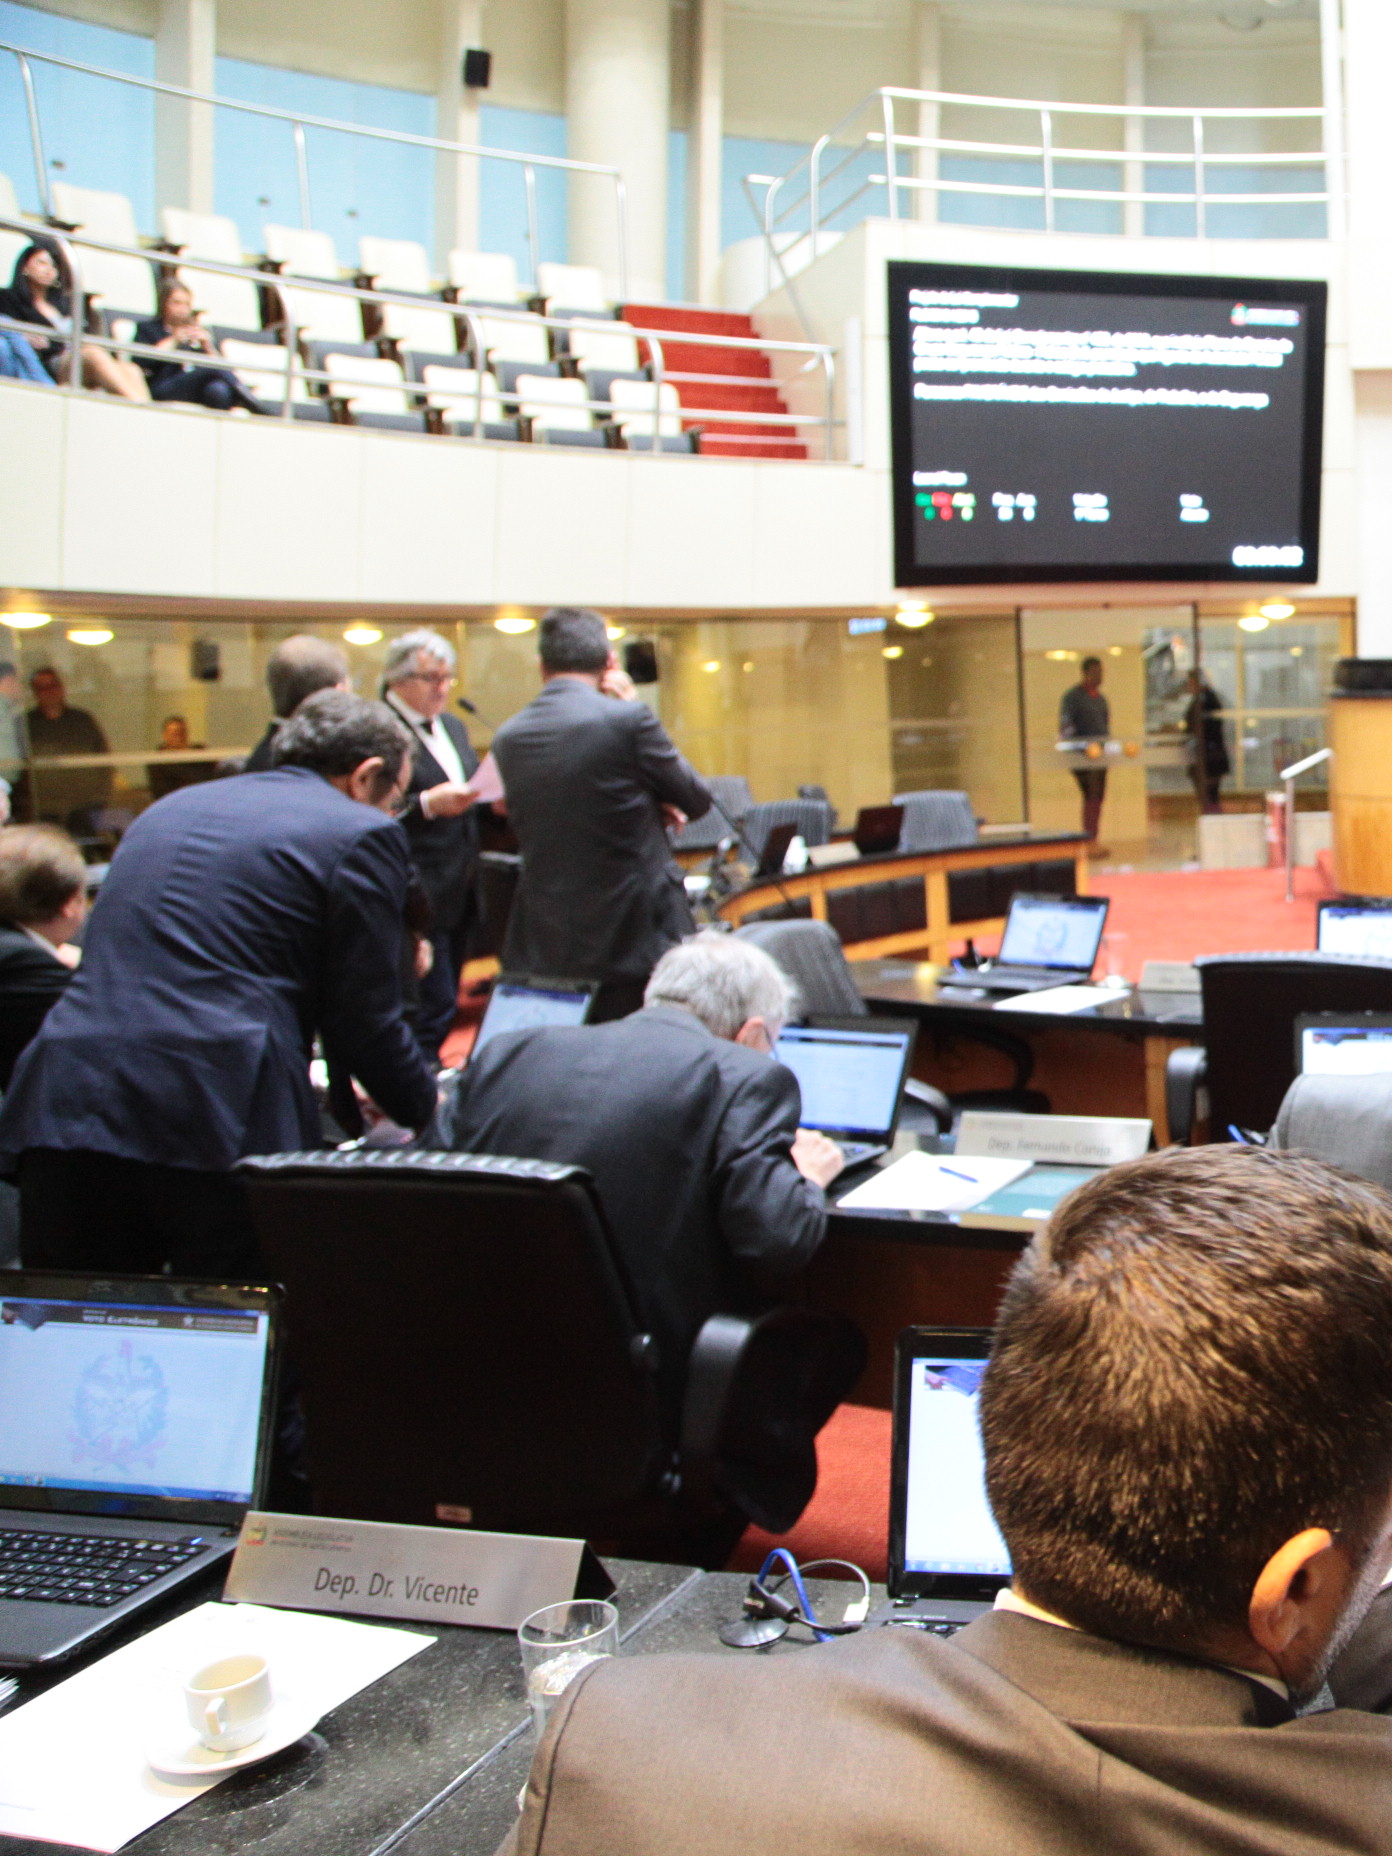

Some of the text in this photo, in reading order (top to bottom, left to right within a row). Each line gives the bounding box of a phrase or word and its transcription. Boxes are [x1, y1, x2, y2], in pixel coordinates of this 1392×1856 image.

[314, 1567, 479, 1606] Dep. Dr. Vicente
